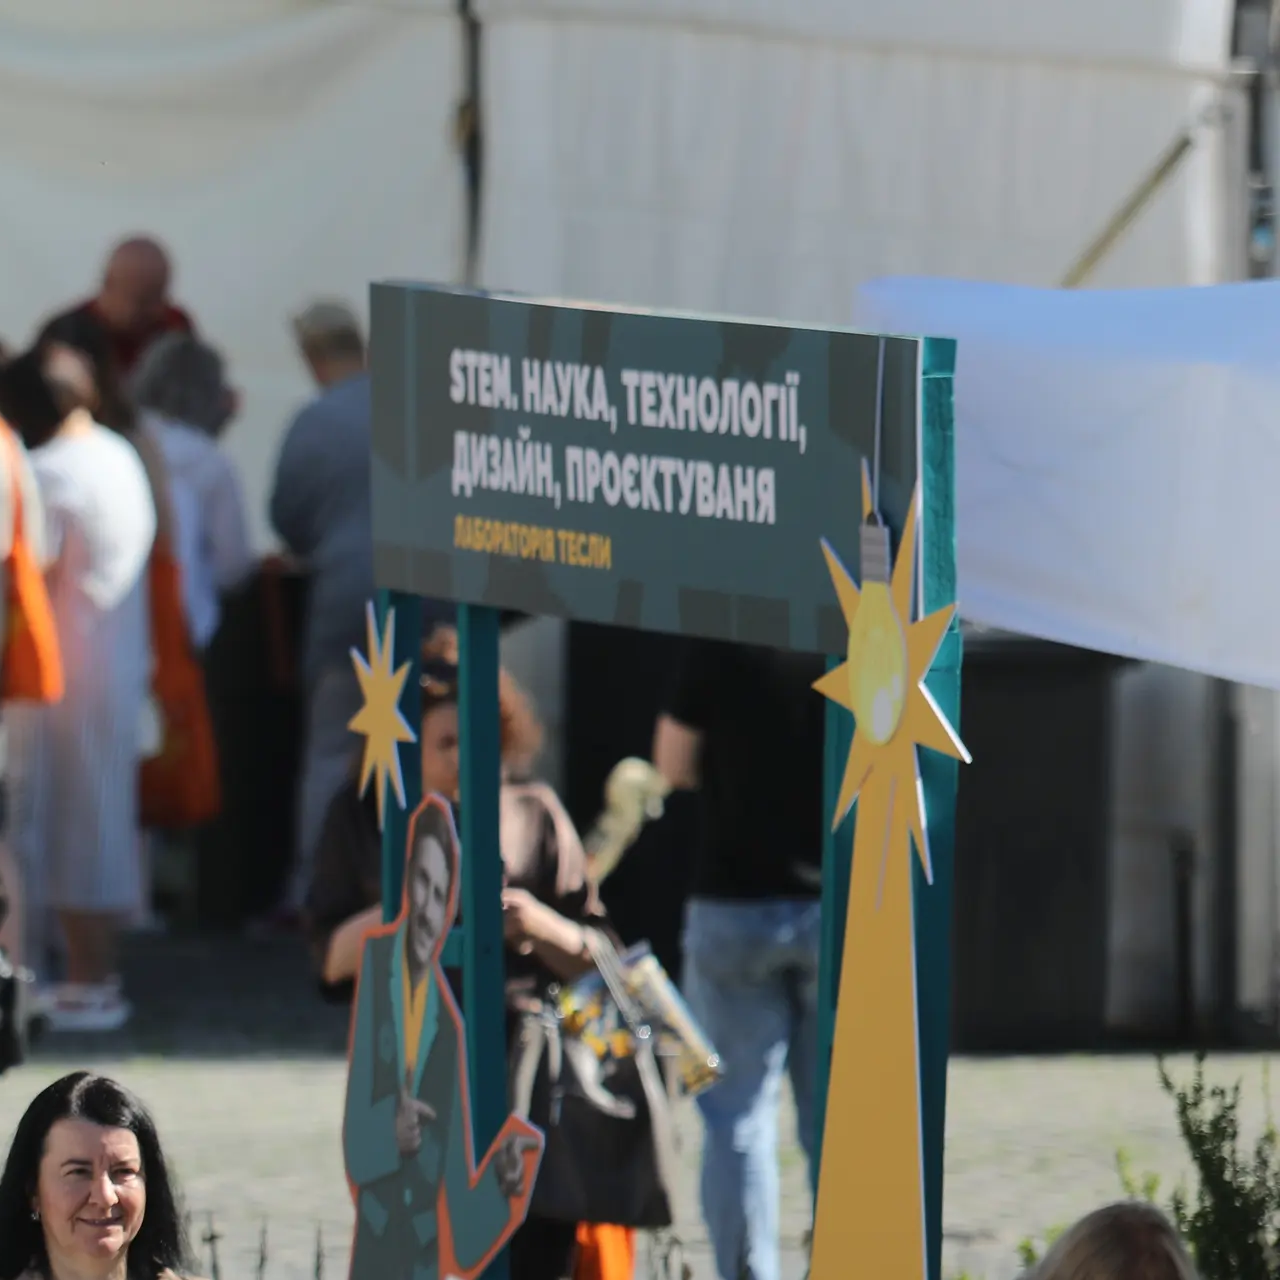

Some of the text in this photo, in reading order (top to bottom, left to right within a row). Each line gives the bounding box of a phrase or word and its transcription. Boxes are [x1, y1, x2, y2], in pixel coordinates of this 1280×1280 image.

[449, 348, 807, 455] STEM. НАУКА, ТЕХНОЛОГІЇ,
[451, 424, 777, 525] ДИЗАЙН, ПРОЄКТУВАНЯ
